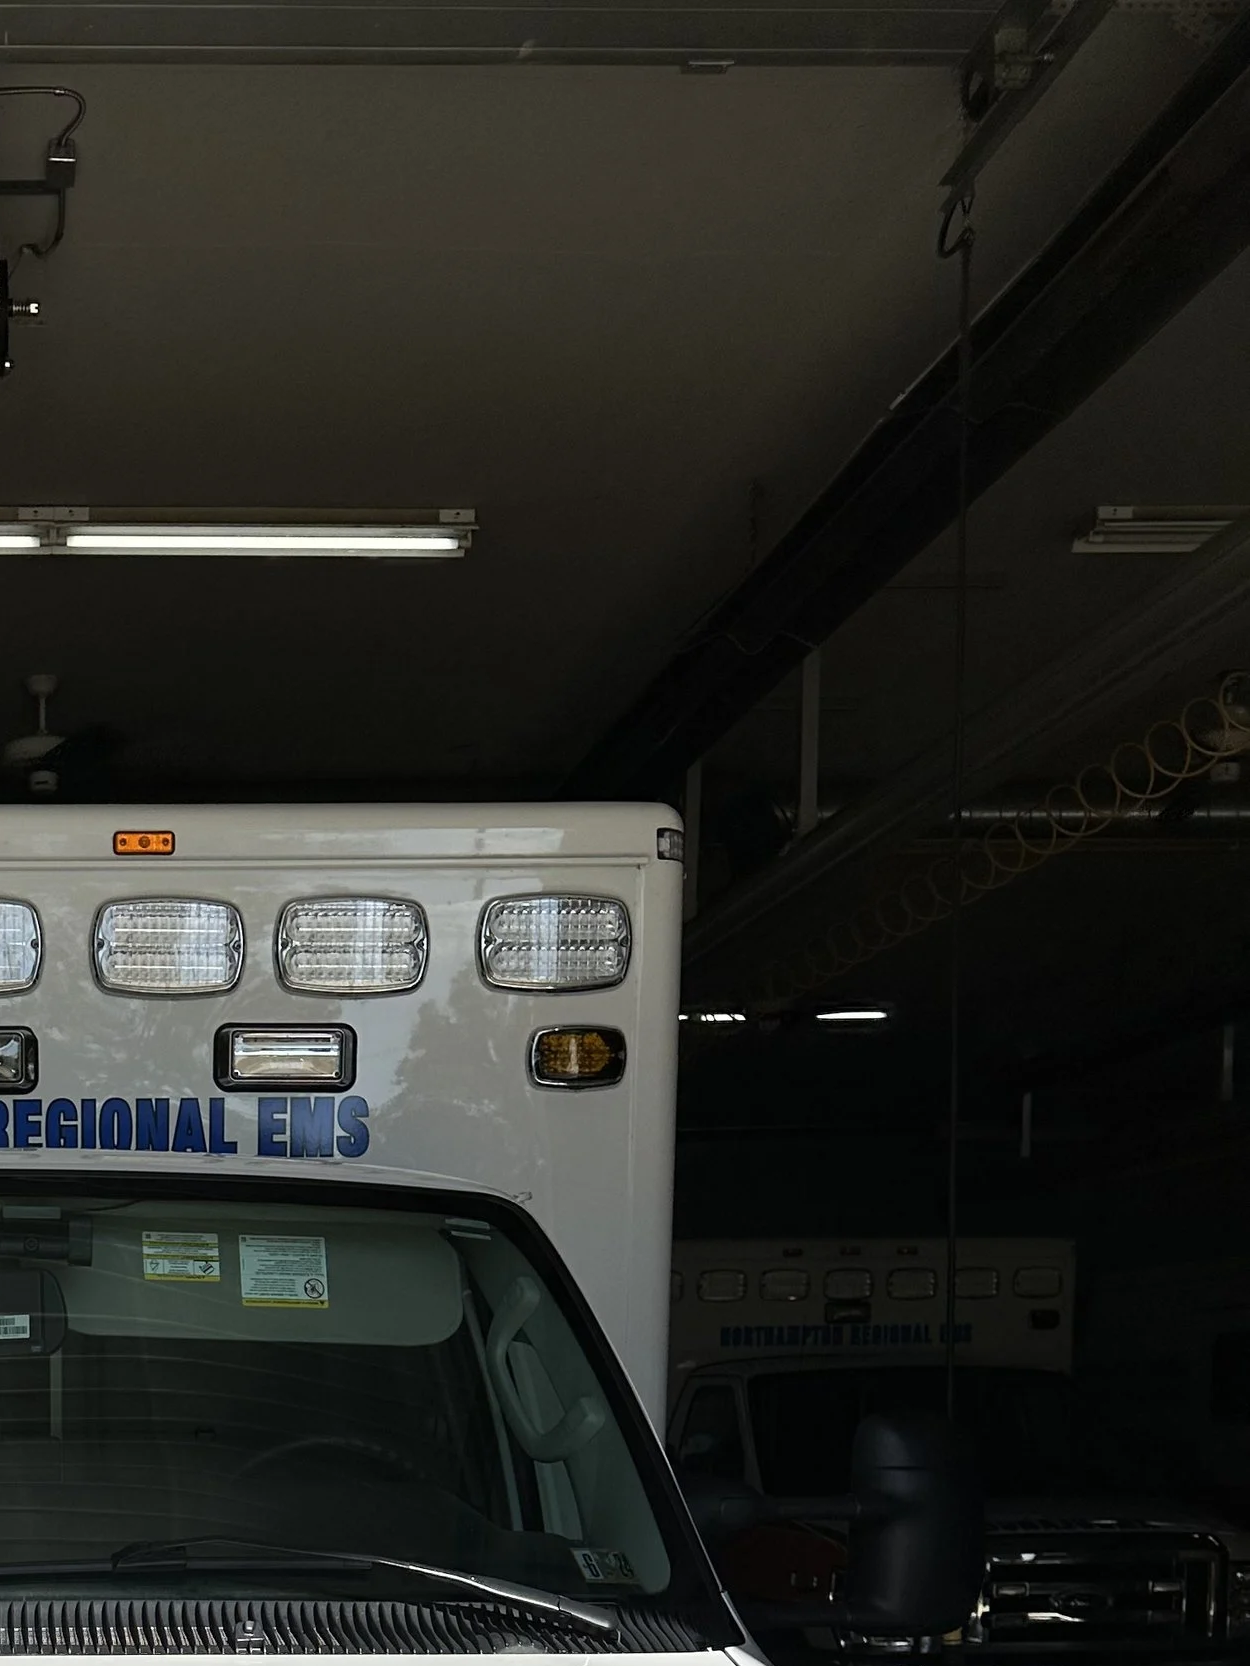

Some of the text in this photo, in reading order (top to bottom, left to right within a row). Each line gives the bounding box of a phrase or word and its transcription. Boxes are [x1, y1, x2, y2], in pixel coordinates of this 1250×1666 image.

[258, 1097, 371, 1158] EMS
[720, 1325, 844, 1348] NORTHAMPTON
[850, 1324, 933, 1345] REGIONAL
